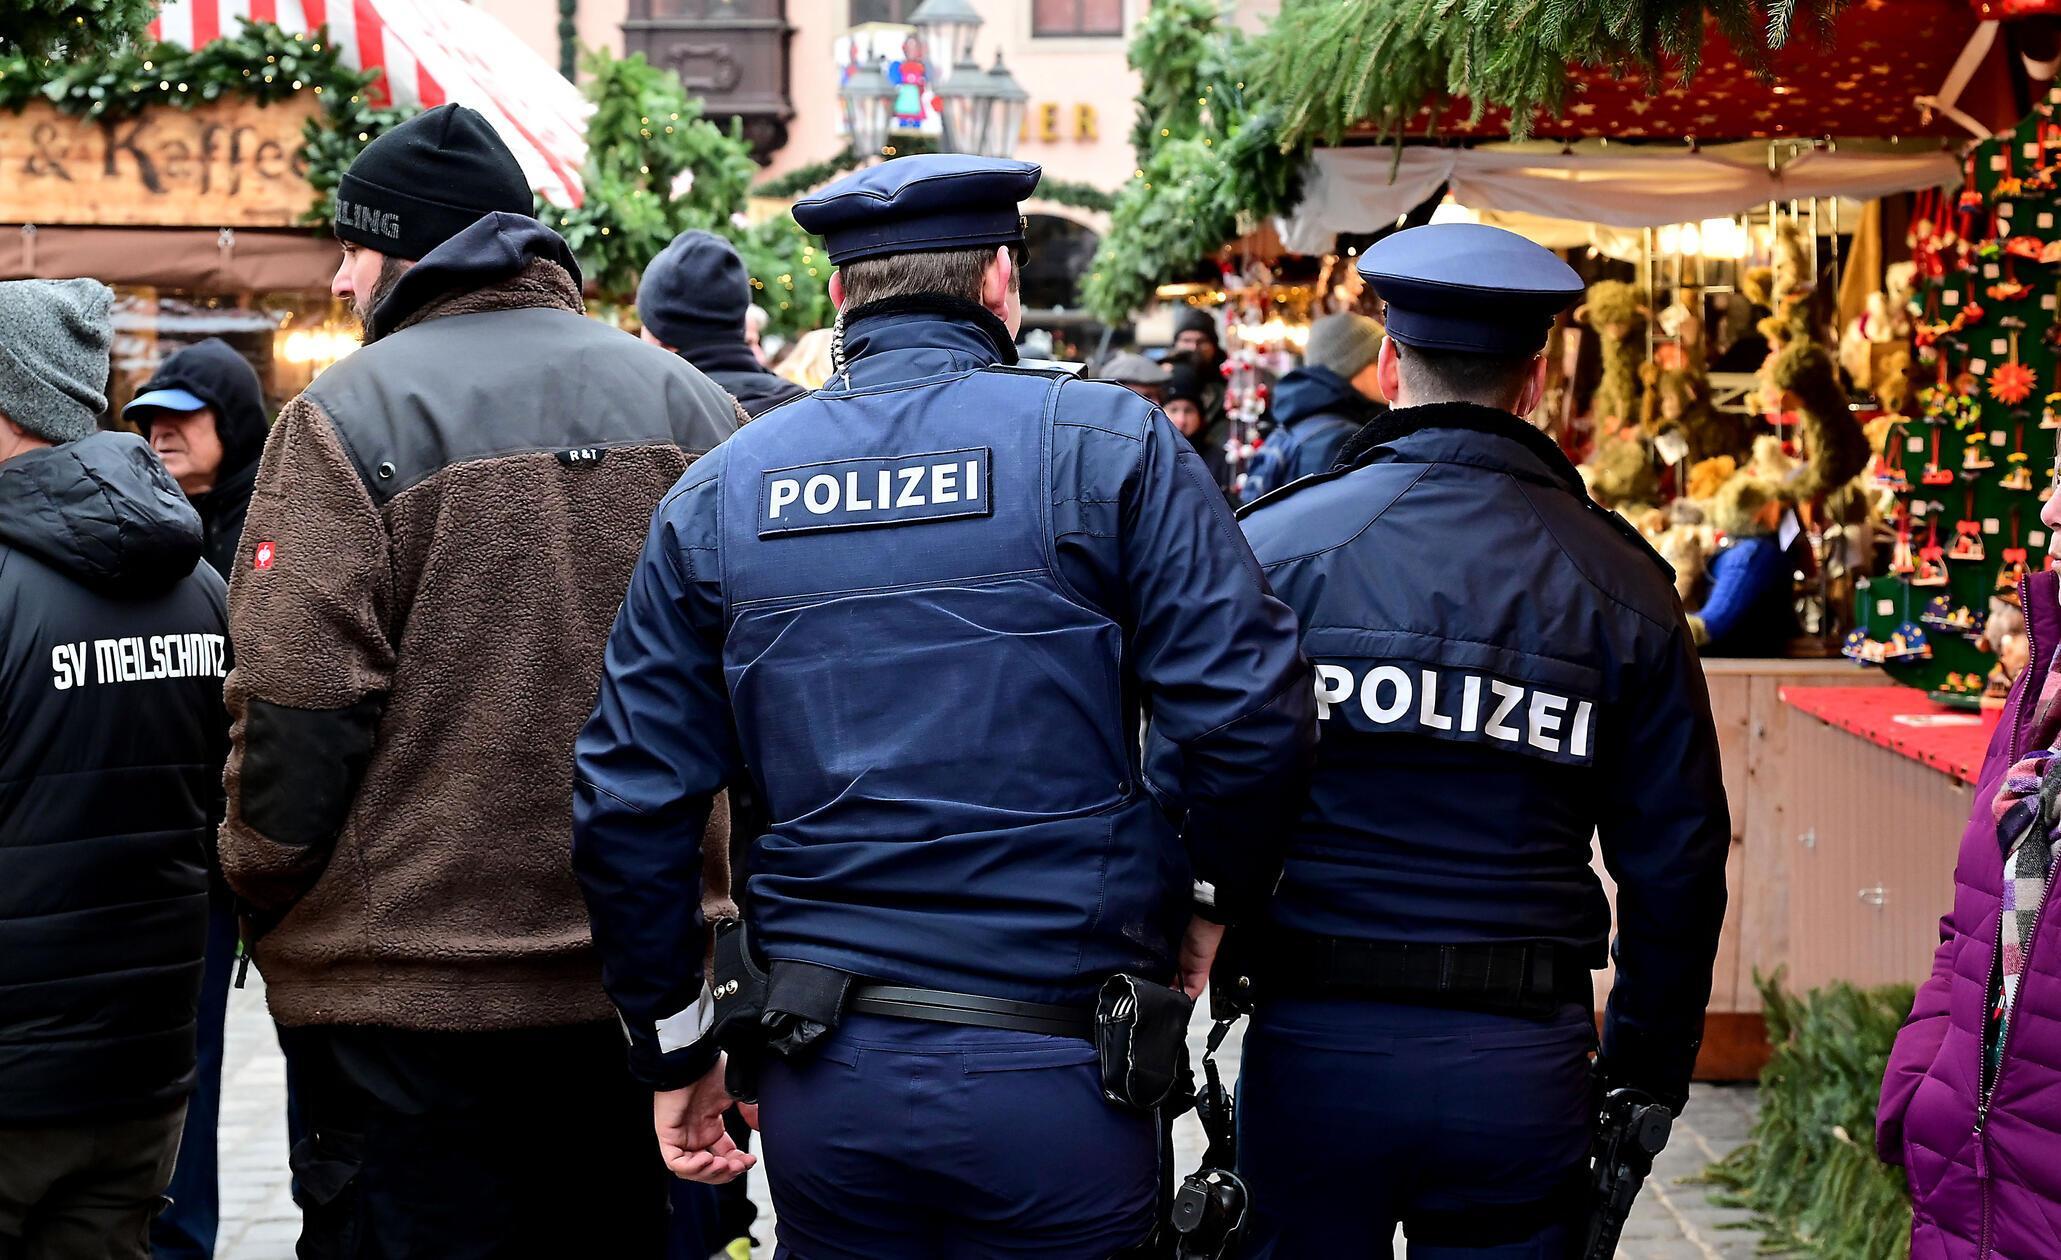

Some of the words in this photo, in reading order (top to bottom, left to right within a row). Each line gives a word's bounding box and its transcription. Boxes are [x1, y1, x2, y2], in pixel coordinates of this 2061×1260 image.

[24, 121, 73, 182] &
[1017, 102, 1099, 144] ER
[769, 460, 978, 519] POLIZEI
[52, 641, 87, 690] SV
[94, 633, 227, 684] MEILSCHNITZ
[1314, 664, 1593, 757] POLIZEI
